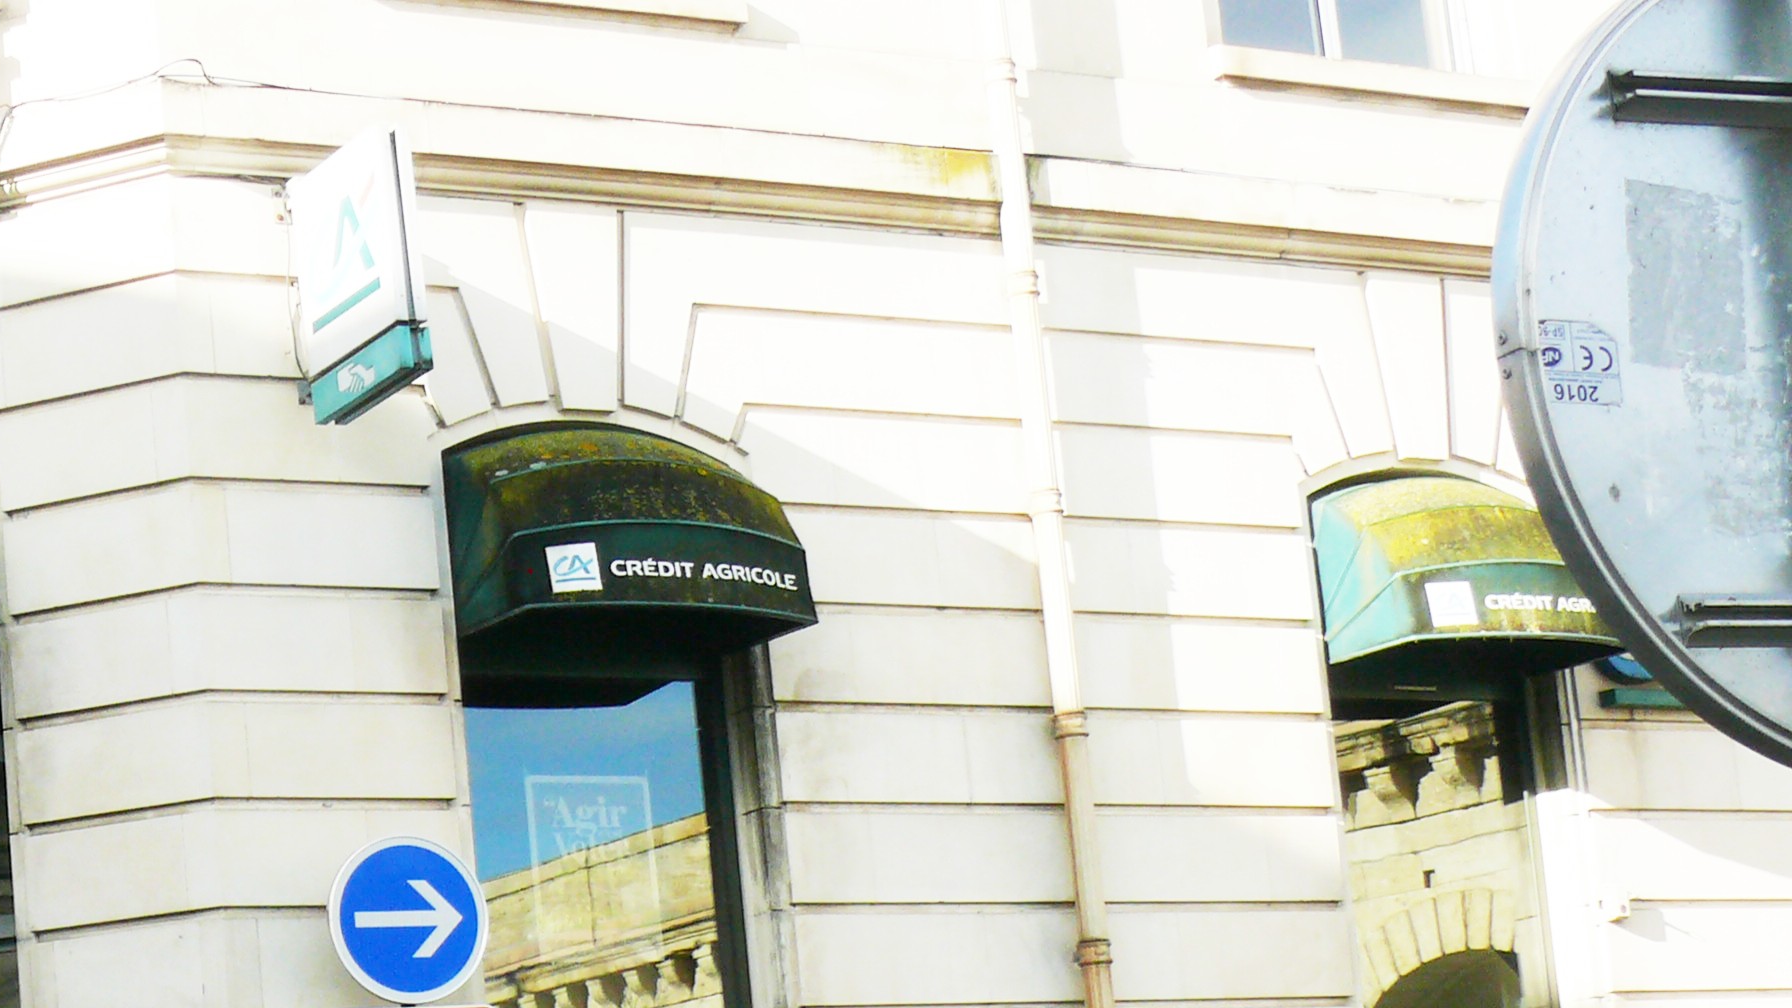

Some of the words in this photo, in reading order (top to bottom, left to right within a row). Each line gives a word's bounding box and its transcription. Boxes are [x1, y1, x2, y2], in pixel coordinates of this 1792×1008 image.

[1554, 383, 1599, 402] 2016
[610, 557, 694, 578] CRÉDIT
[702, 563, 798, 591] AGRICOLE
[1484, 592, 1553, 611] CRÉDIT
[1557, 596, 1597, 613] AGR
